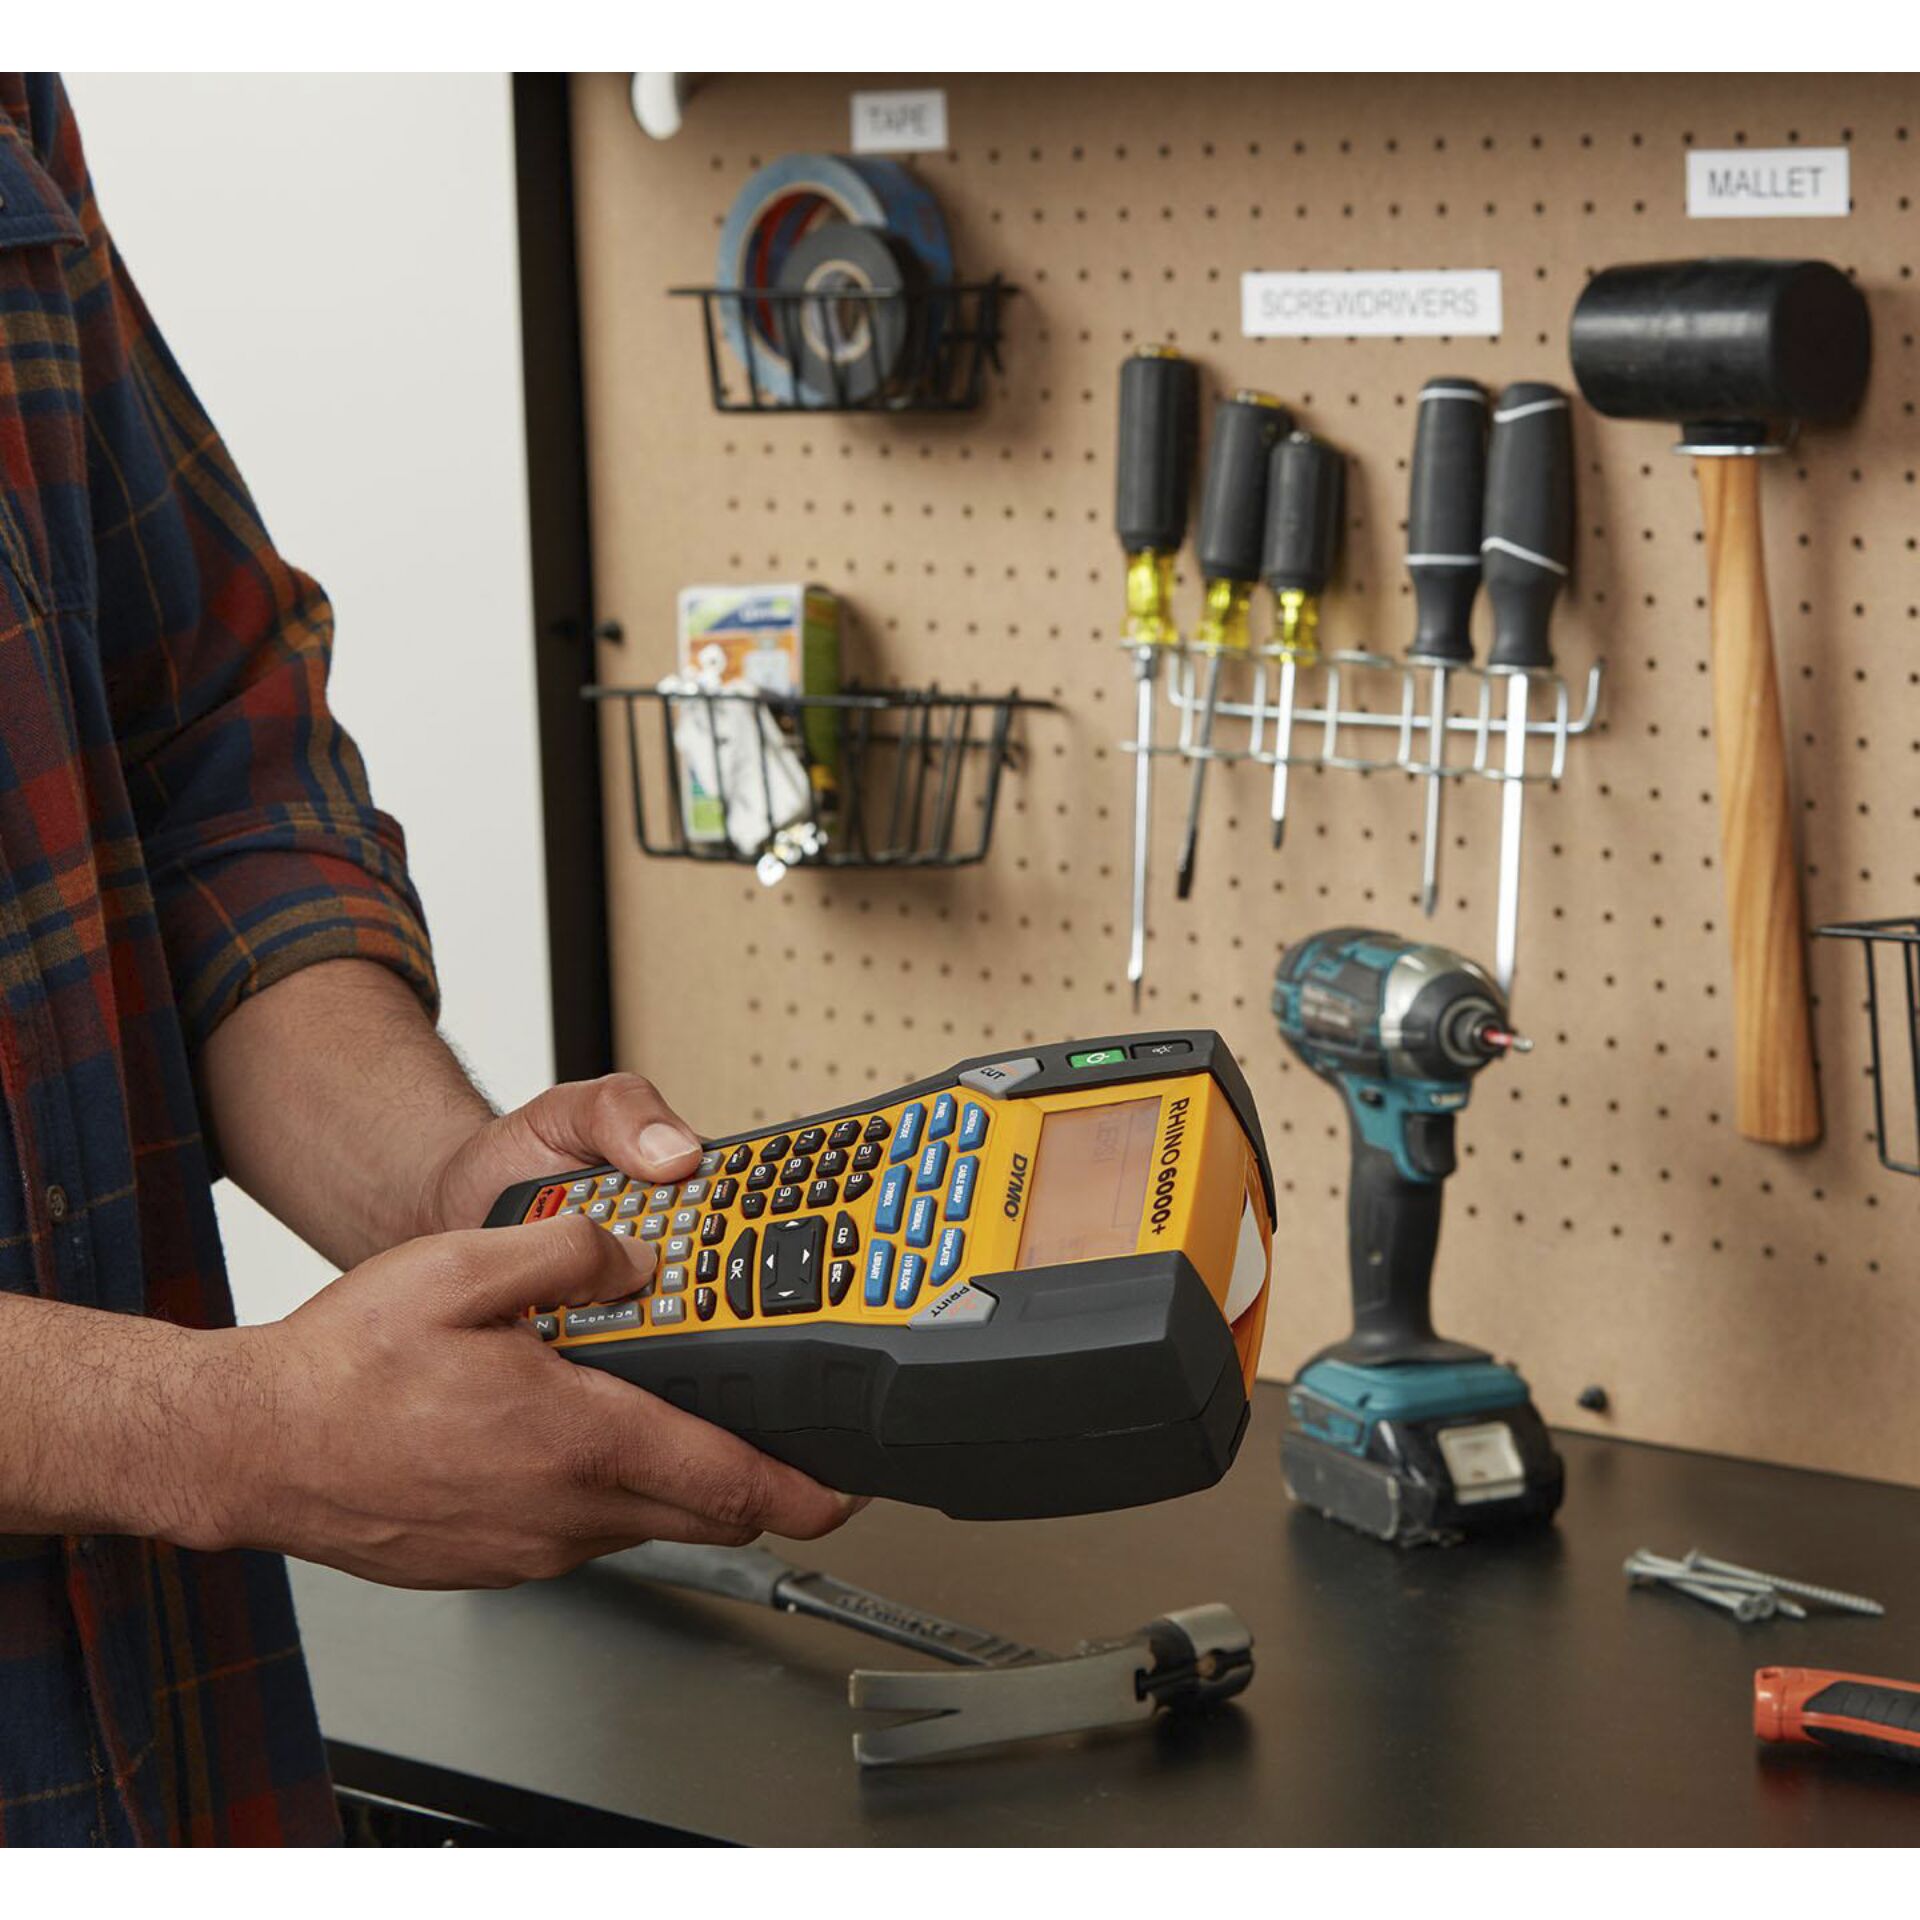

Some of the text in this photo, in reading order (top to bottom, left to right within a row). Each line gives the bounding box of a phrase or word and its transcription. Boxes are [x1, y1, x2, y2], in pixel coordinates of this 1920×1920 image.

[1708, 166, 1826, 198] MALLET
[1261, 286, 1479, 319] SCREWDRIVERS
[980, 1067, 1006, 1080] CUT
[1151, 1096, 1190, 1235] RHINO 6000+
[688, 1184, 700, 1193] B
[1004, 1152, 1028, 1217] DYMO
[655, 1190, 668, 1200] G
[644, 1219, 658, 1228] H
[678, 1212, 690, 1222] C
[671, 1240, 683, 1250] D
[665, 1270, 678, 1279] E
[730, 1258, 744, 1280] OK
[831, 1263, 843, 1283] ESC
[930, 1286, 971, 1318] PRINT
